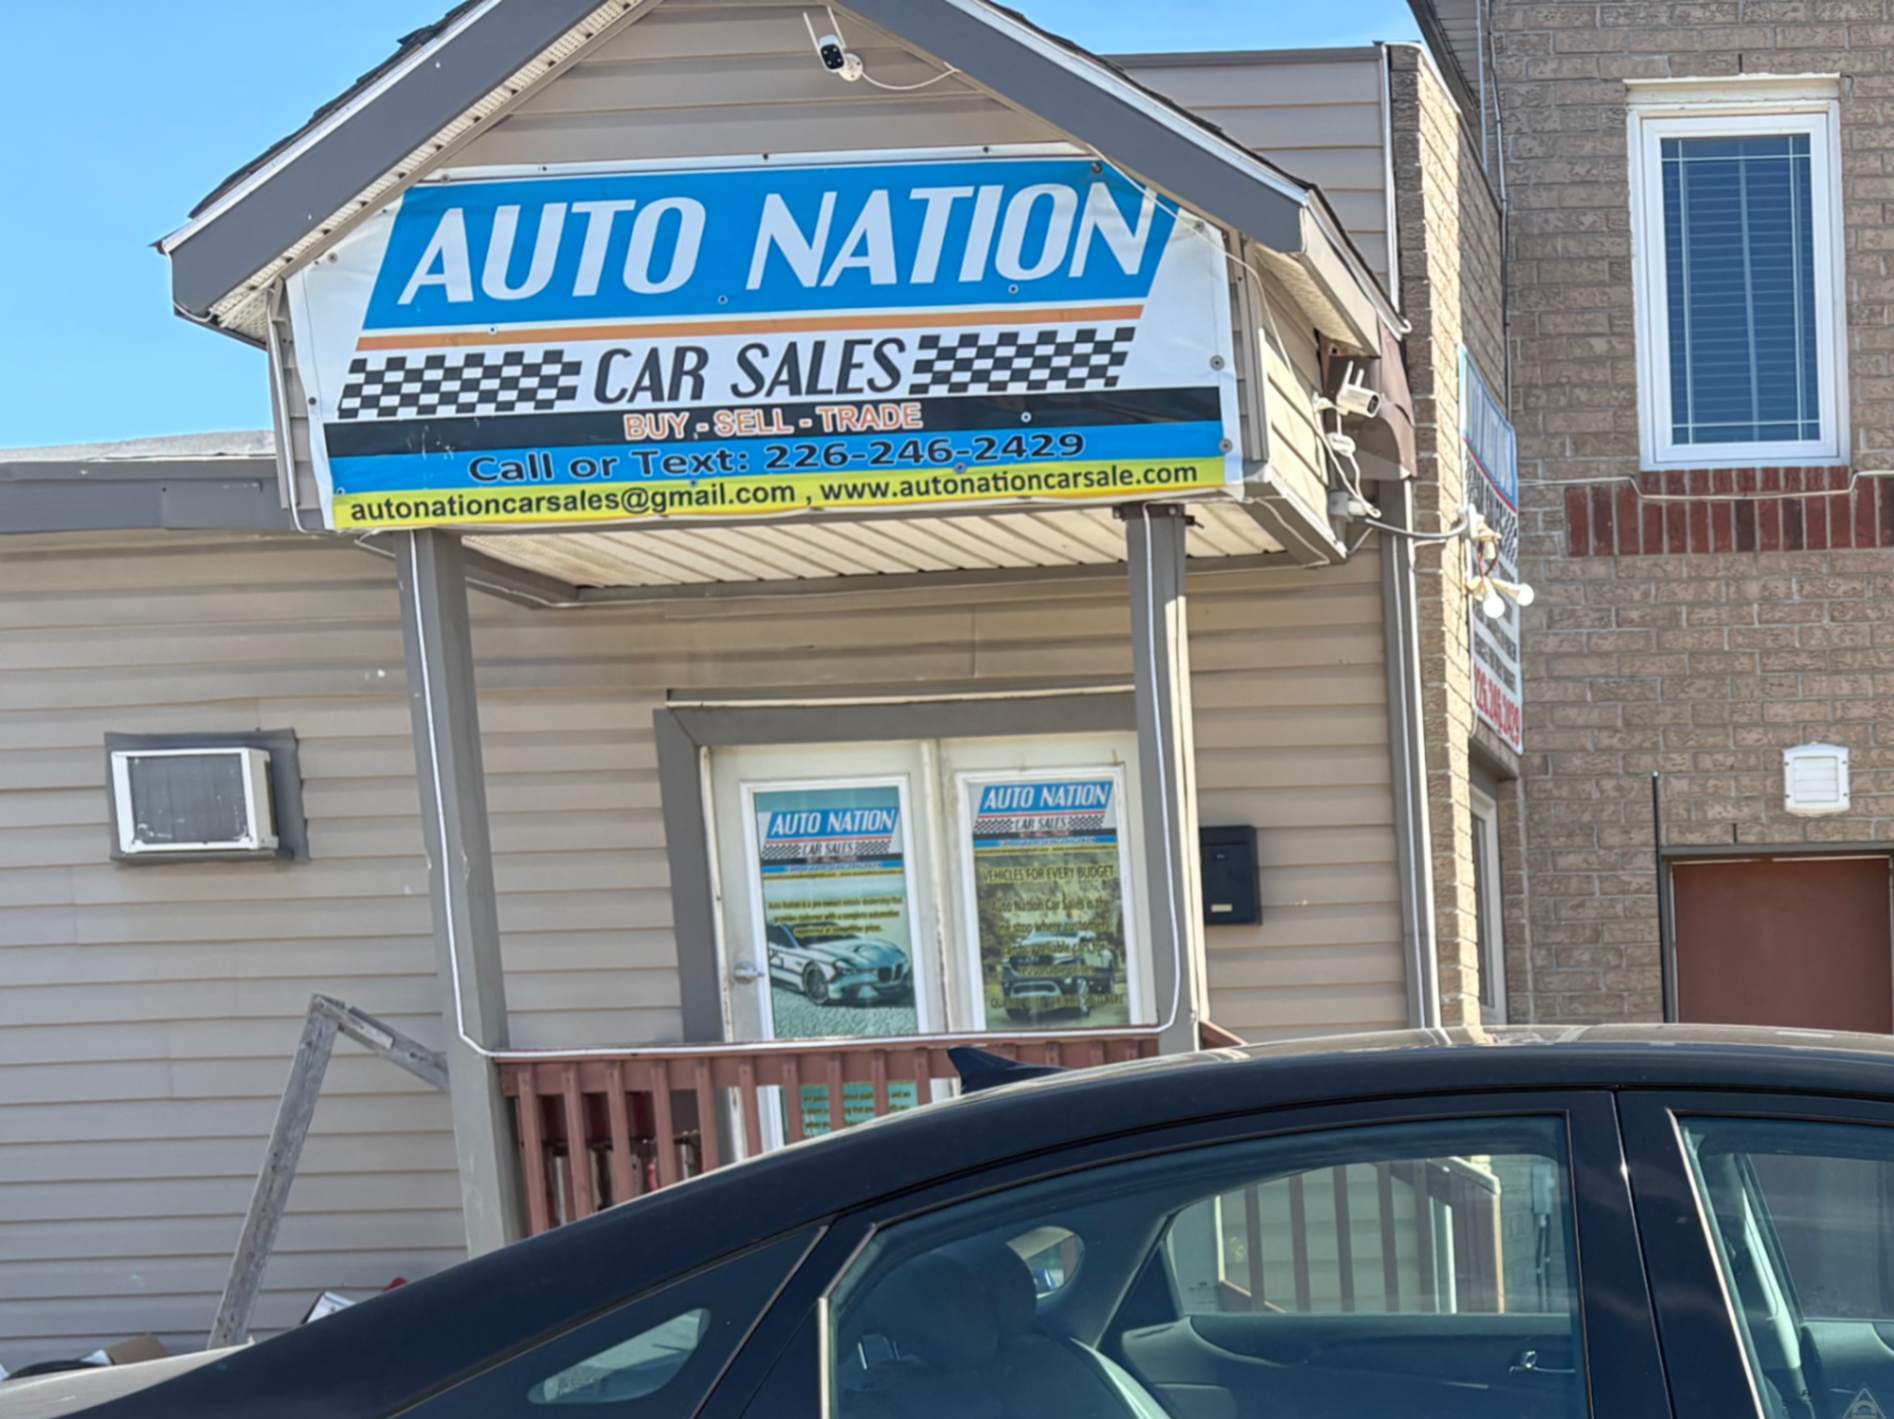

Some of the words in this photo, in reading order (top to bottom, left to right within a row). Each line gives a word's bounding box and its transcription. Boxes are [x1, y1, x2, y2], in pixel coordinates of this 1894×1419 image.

[396, 196, 706, 306] AUTO
[745, 181, 1159, 292] NATION
[593, 347, 706, 404] CAR
[730, 337, 906, 400] SALES
[623, 412, 686, 441] BUY
[714, 407, 793, 437] SELL
[816, 402, 924, 433] TRADE
[468, 452, 553, 483] Call
[569, 455, 618, 479] or
[631, 447, 749, 478] Text:
[764, 433, 1085, 470] 226-246-2429
[350, 481, 796, 520] autonationcarsales@gmail.com
[820, 463, 1198, 502] www.autonationcarsale.com
[984, 787, 1035, 810] AUTO
[1040, 784, 1109, 807] NATION
[771, 812, 822, 836] AUTO
[827, 809, 895, 833] NATION
